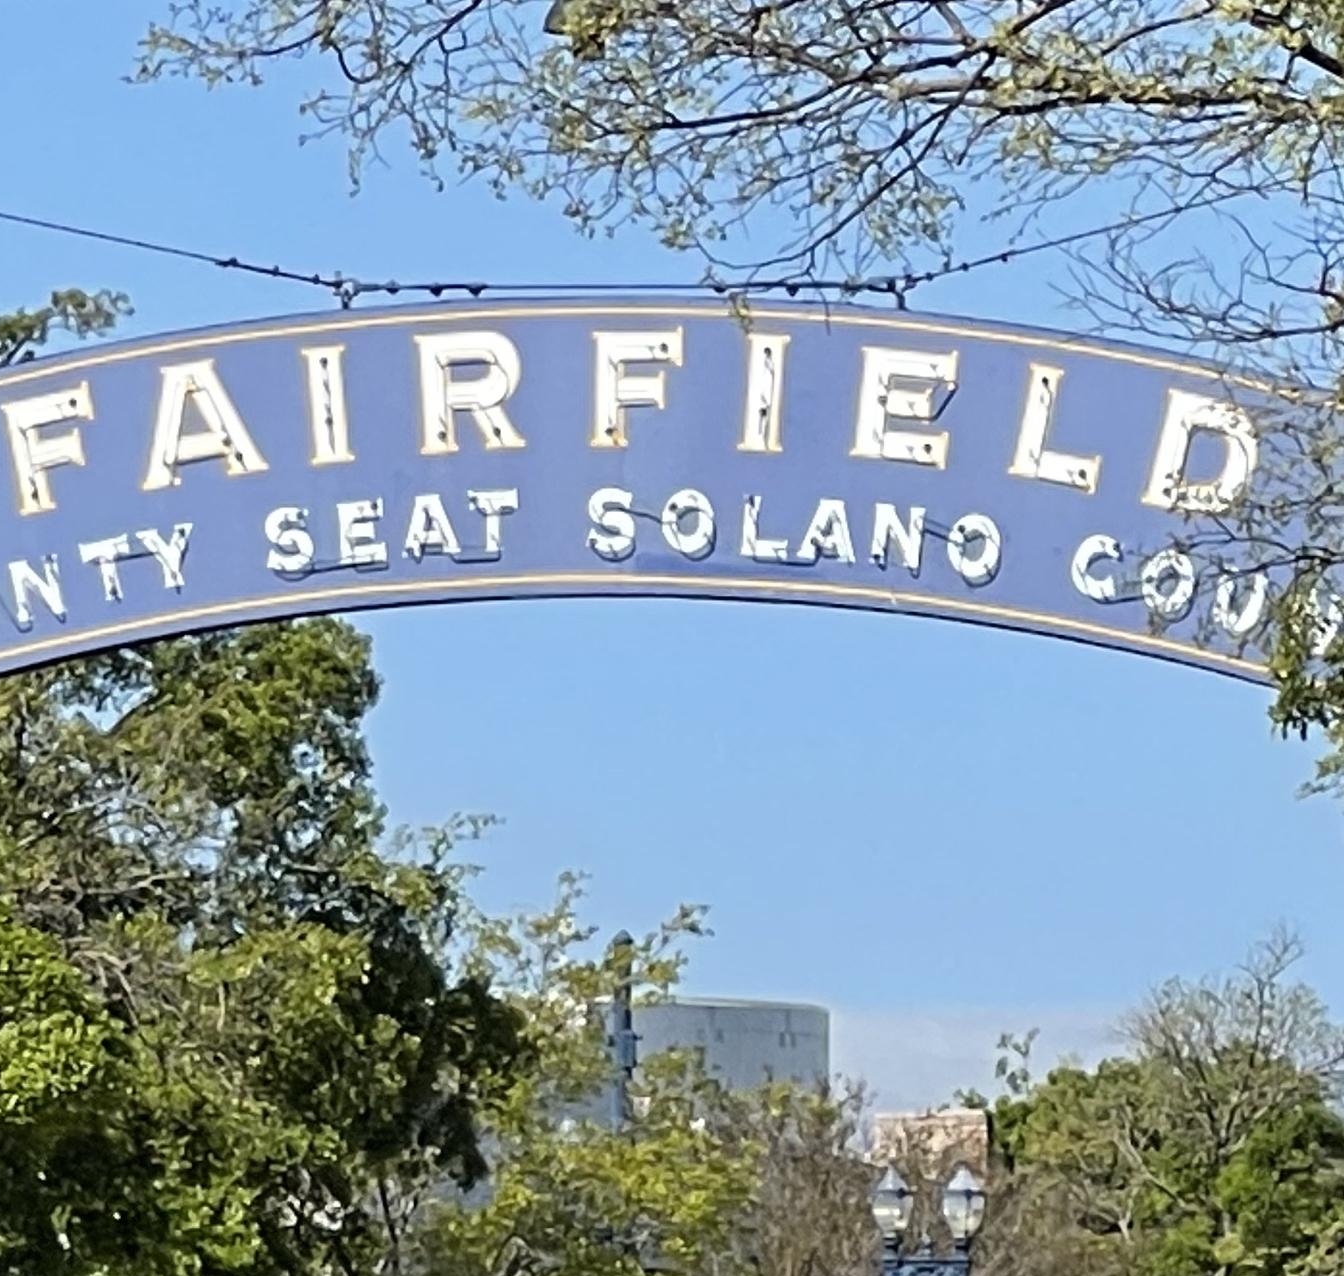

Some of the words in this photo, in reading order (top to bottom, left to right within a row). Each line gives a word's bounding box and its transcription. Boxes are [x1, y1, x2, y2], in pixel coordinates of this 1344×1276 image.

[0, 327, 1258, 517] FAIRFIELD
[264, 487, 520, 578] SEAT
[586, 486, 1002, 588] SOLANO
